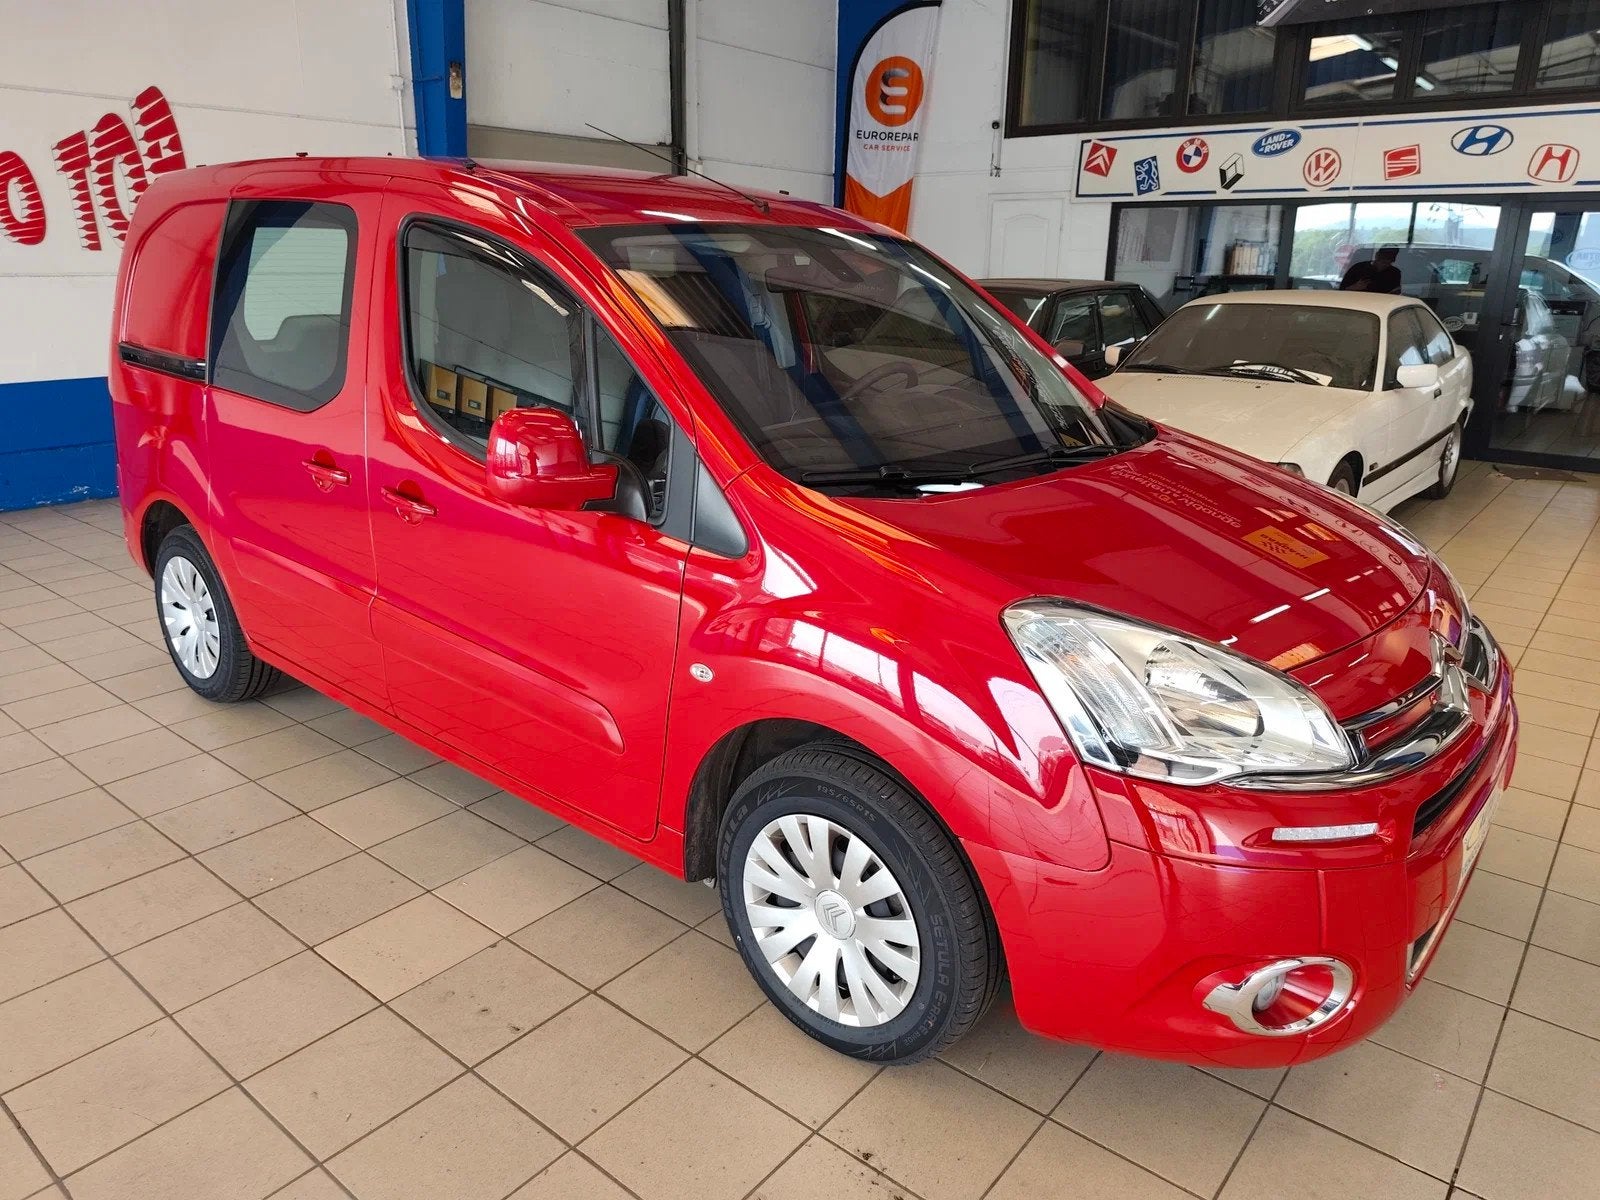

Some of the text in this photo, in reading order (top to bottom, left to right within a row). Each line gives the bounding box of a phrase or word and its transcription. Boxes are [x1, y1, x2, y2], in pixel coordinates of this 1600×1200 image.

[856, 129, 919, 142] EUROREPAR
[1261, 133, 1286, 146] LAND
[1264, 139, 1295, 154] ROVER
[929, 914, 952, 986] SETULA
